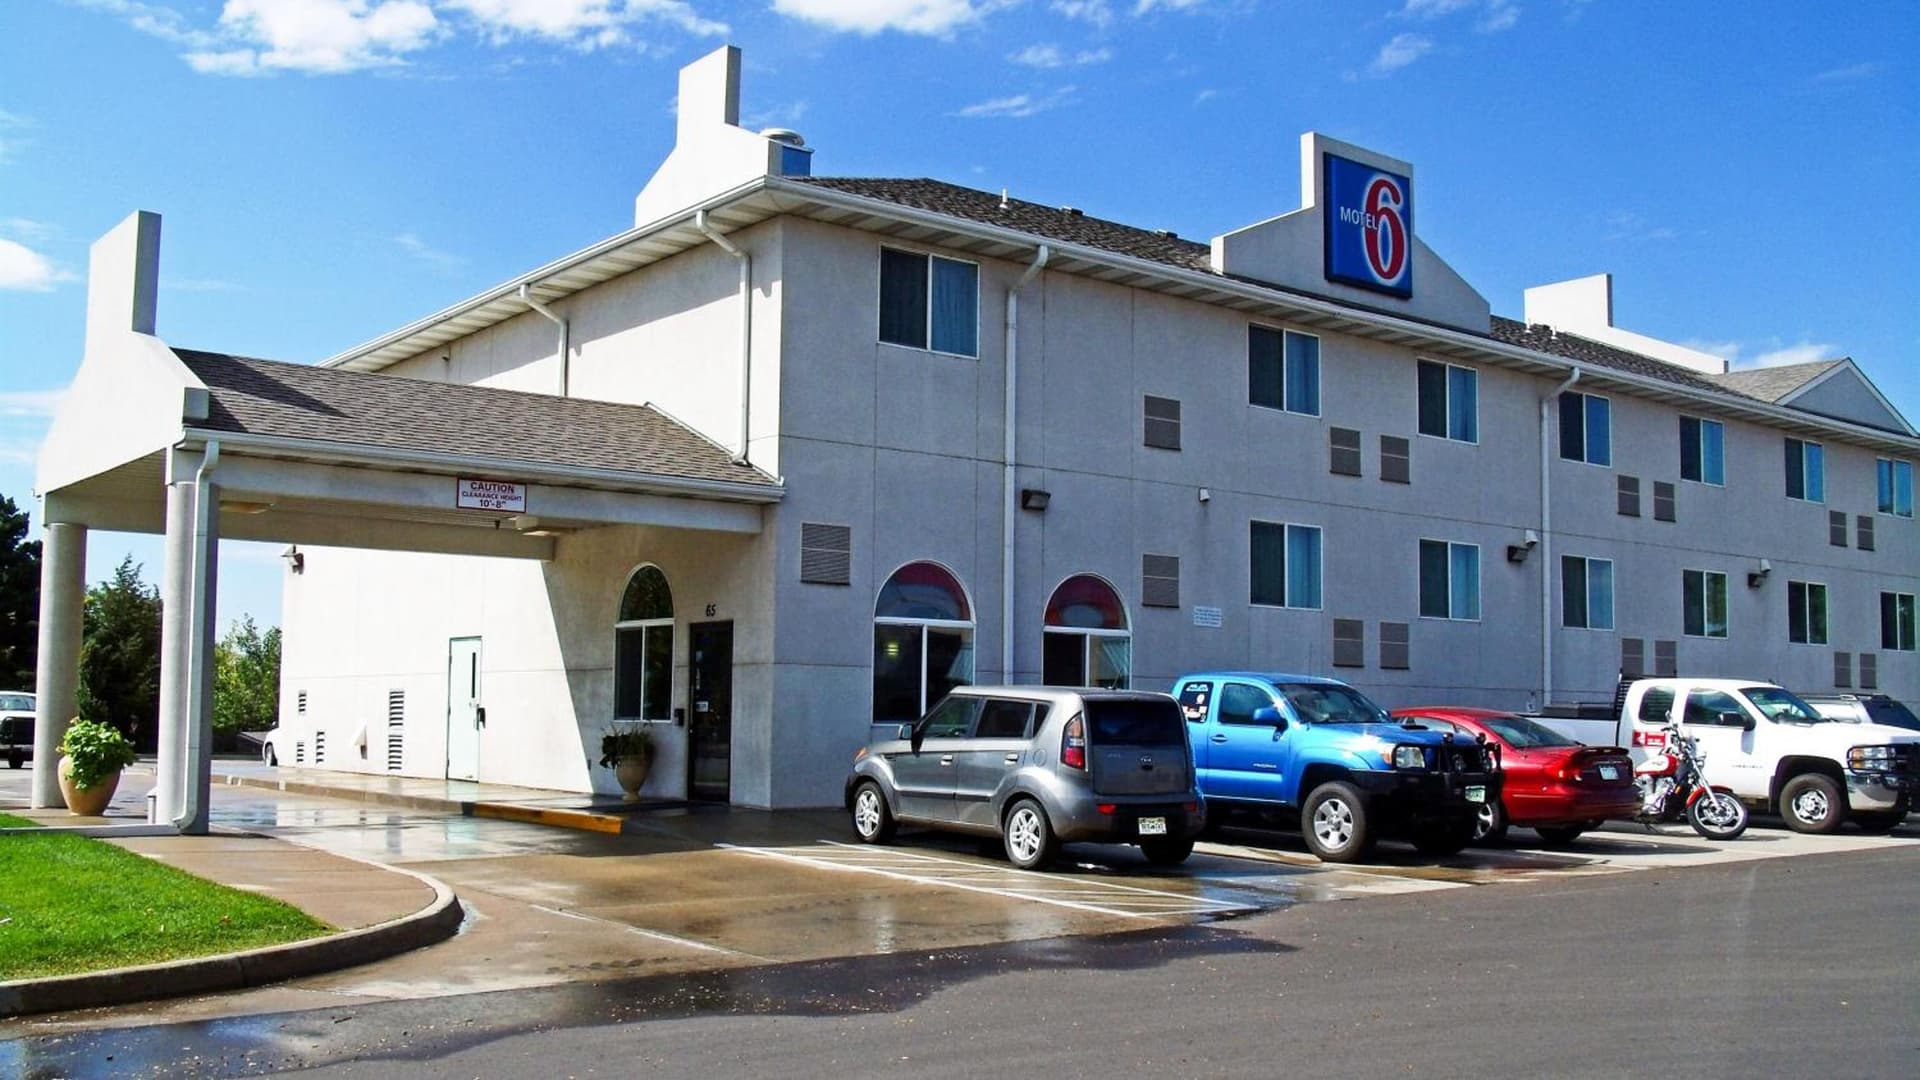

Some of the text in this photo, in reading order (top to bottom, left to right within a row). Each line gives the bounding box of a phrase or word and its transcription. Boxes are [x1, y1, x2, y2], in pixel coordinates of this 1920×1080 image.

[1340, 175, 1406, 285] MOTEL 6
[470, 482, 514, 494] CAUTION
[462, 491, 522, 502] CLEARANCE HEIGHT
[705, 603, 716, 617] 65
